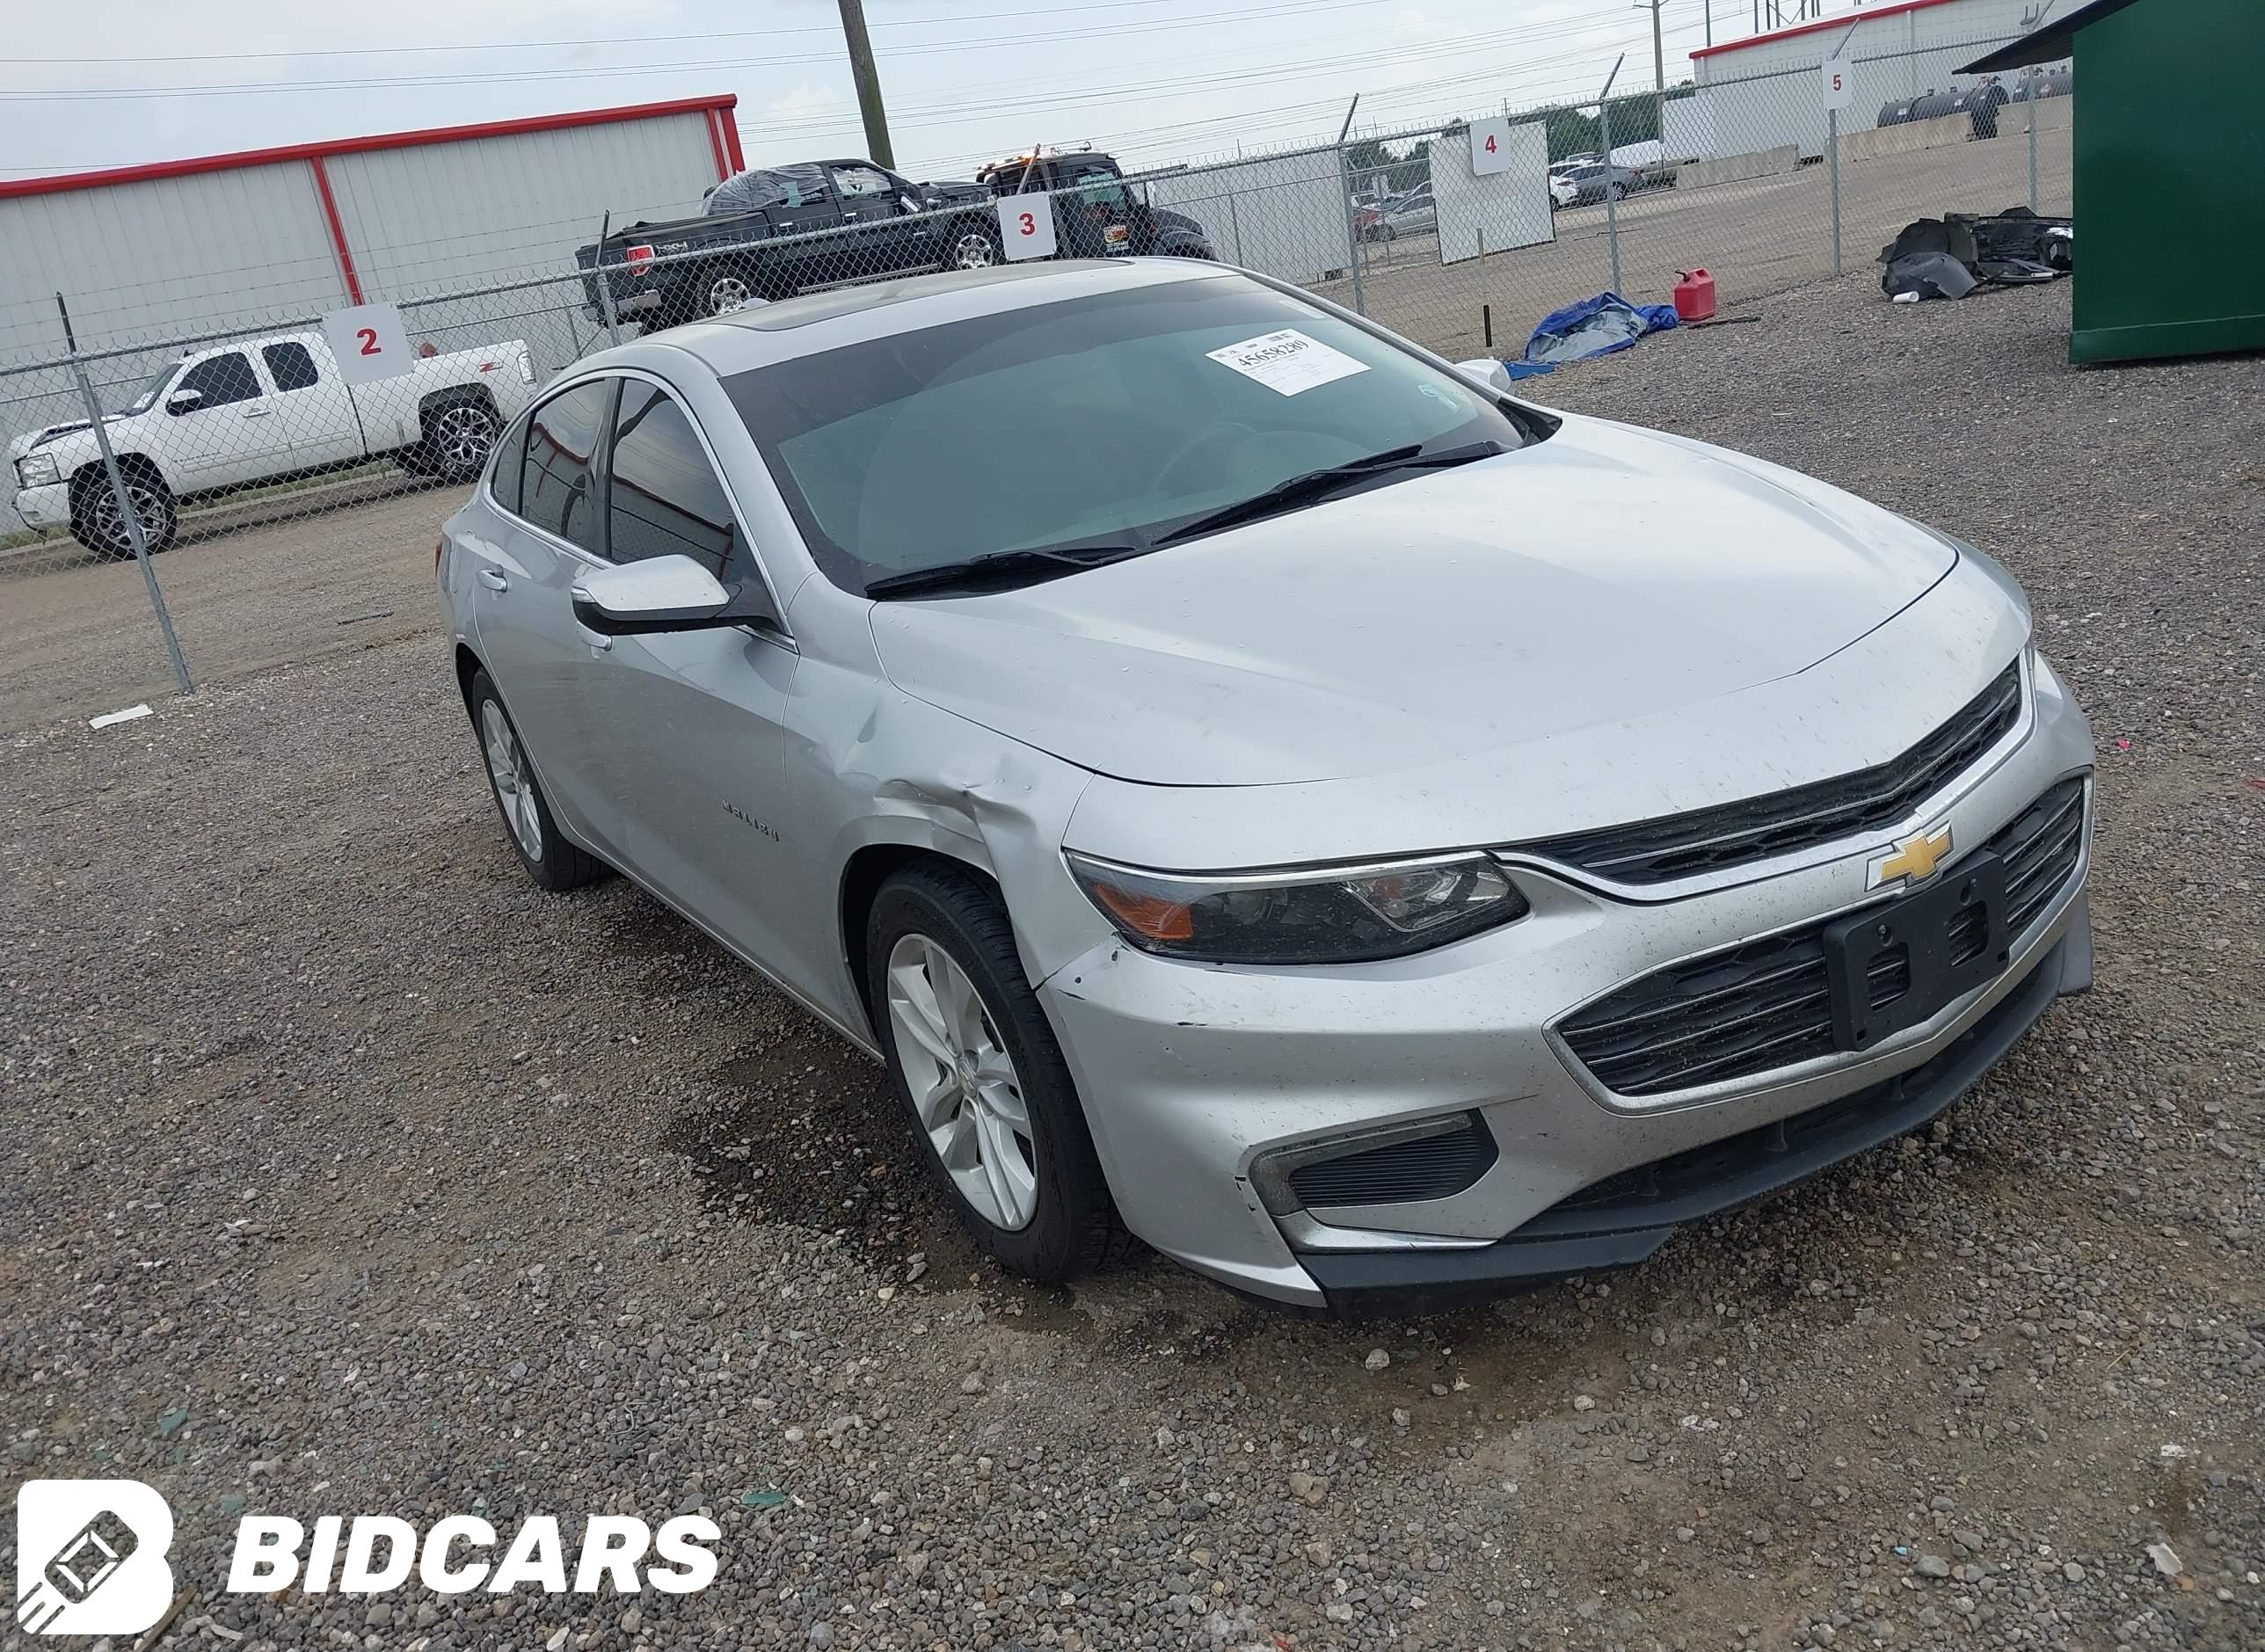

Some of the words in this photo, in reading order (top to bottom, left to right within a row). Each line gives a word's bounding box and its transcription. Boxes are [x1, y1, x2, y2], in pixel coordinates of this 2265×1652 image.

[1833, 74, 1842, 91] 5
[1485, 135, 1497, 154] 4
[1019, 212, 1036, 236] 3
[356, 327, 381, 355] 2
[1237, 339, 1309, 367] 45658289
